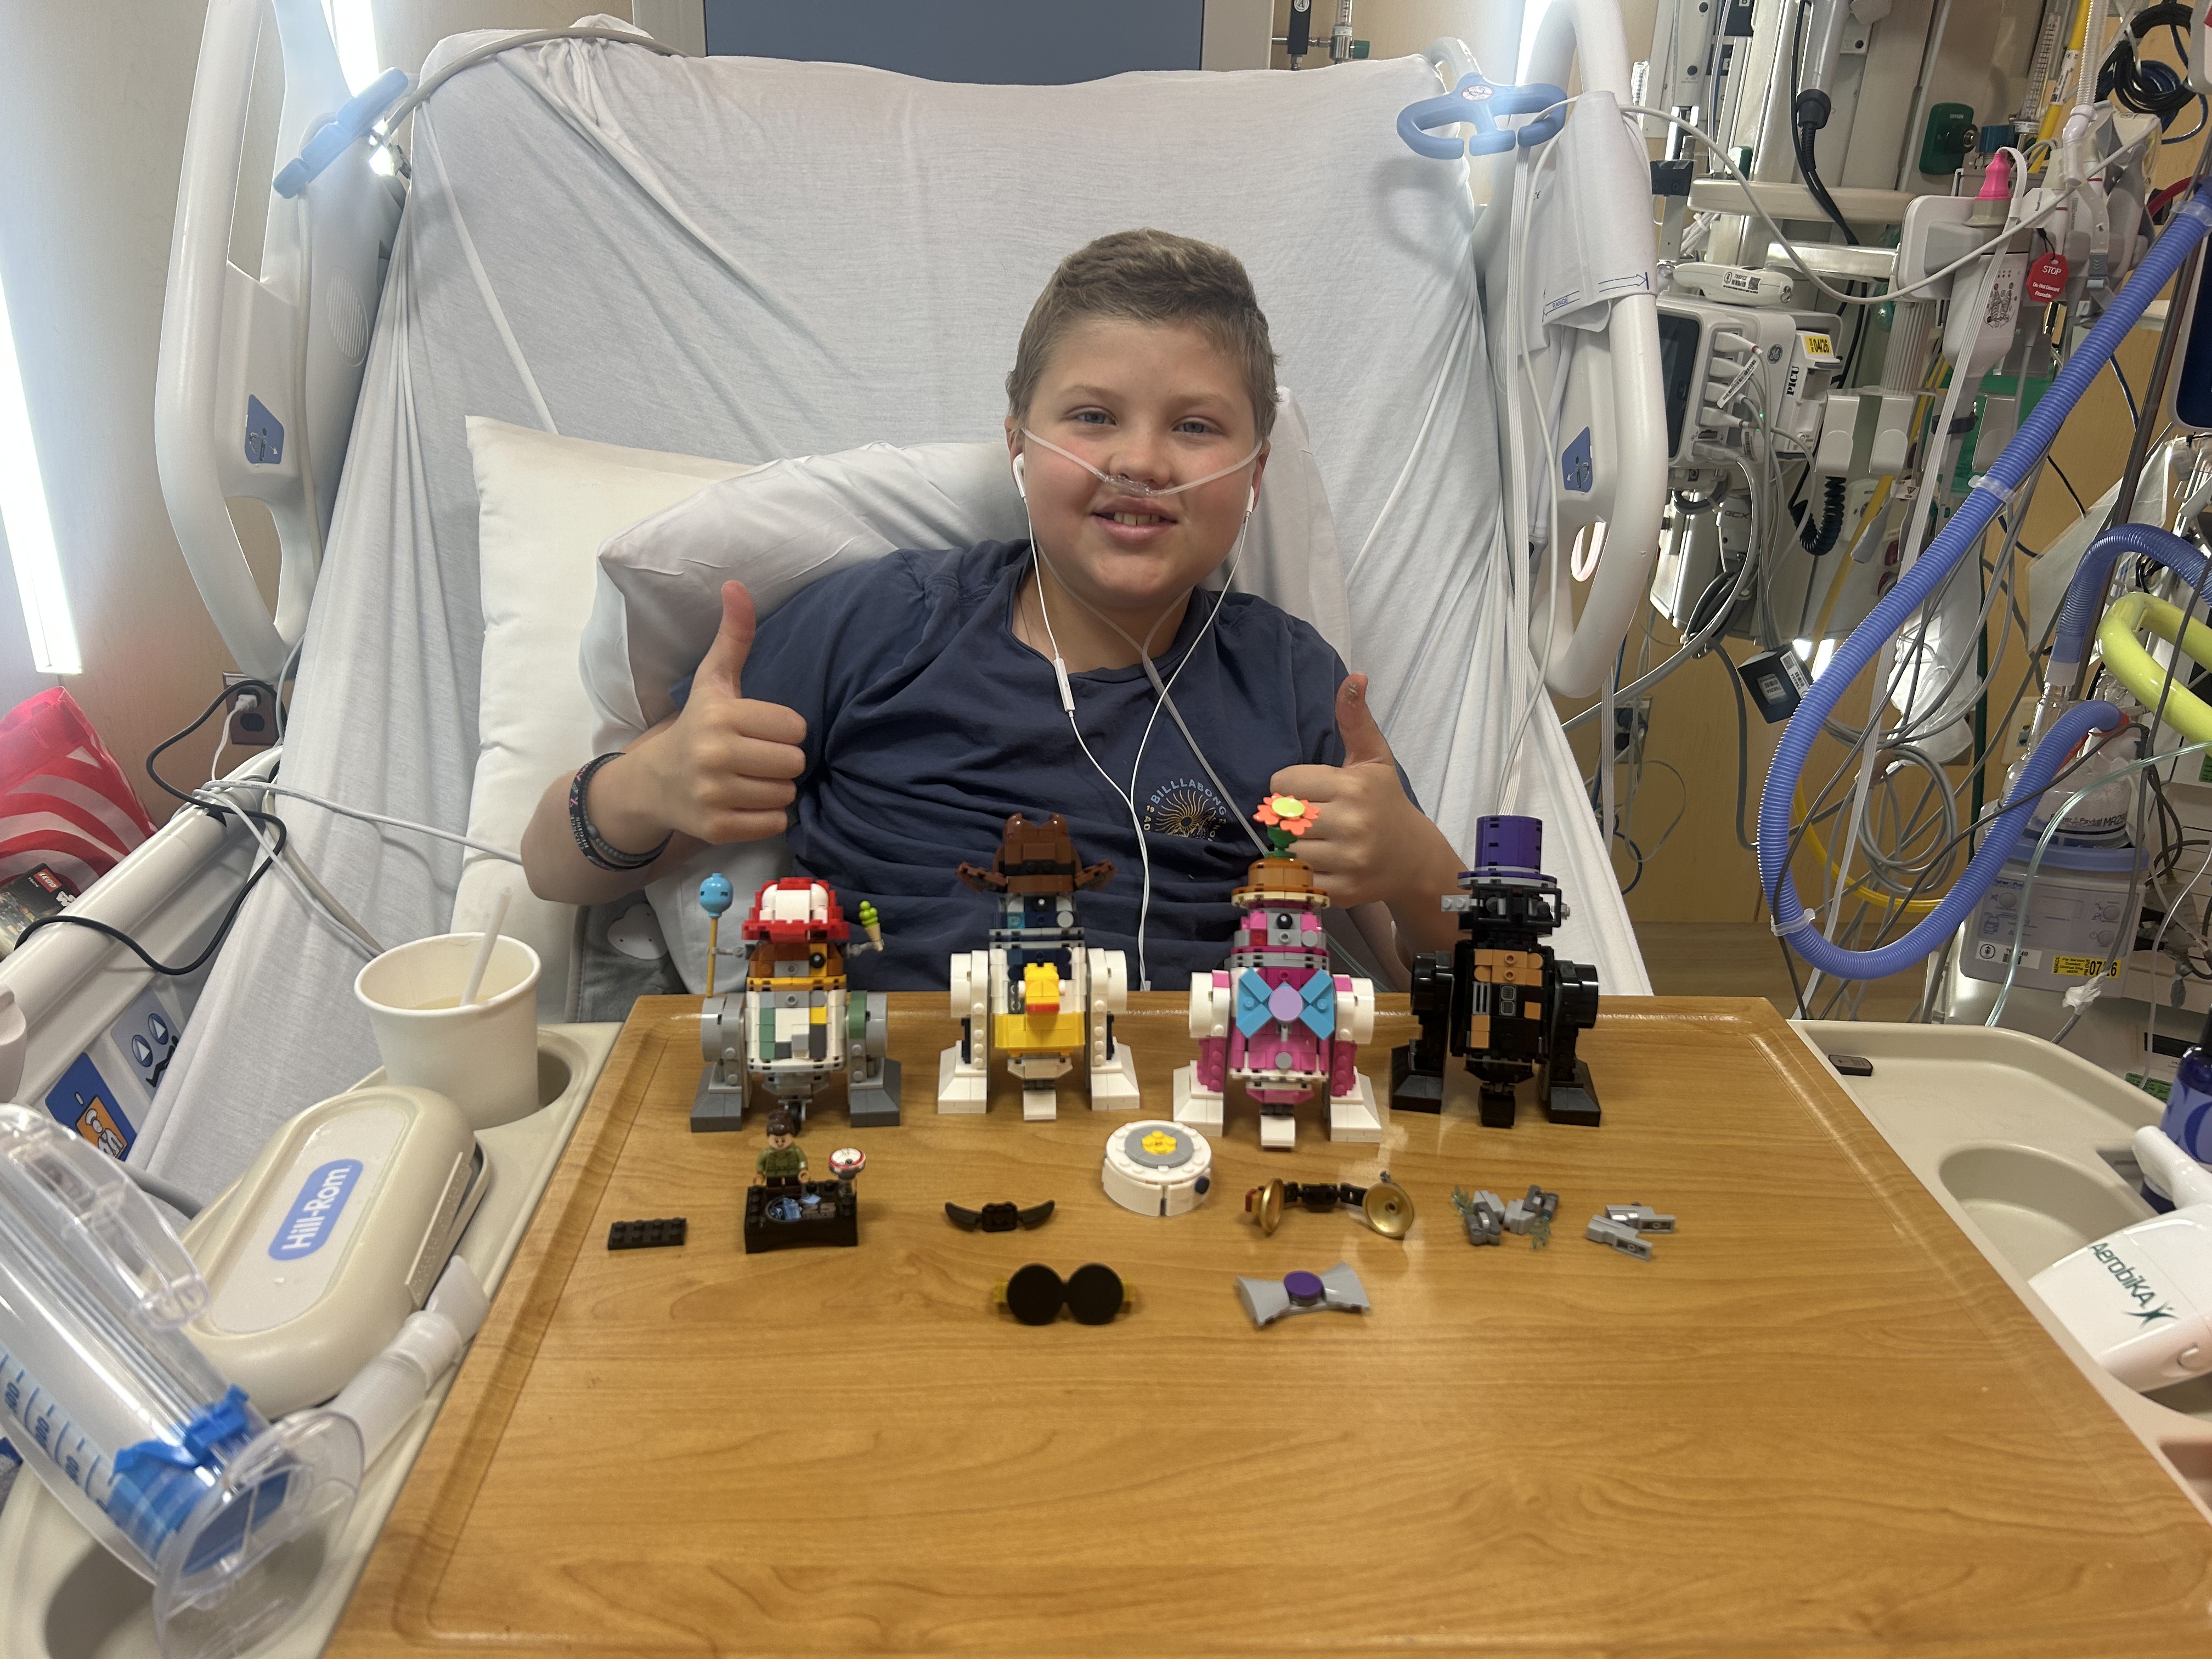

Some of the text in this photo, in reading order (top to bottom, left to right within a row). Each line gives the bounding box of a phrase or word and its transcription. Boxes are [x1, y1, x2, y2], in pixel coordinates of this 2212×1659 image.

[2042, 265, 2062, 275] STOP
[1552, 297, 1568, 309] RANGE
[1813, 338, 1830, 353] 04/26
[1786, 365, 1799, 396] PICU
[1725, 510, 1750, 519] GCX
[38, 872, 58, 888] LEGO
[281, 1167, 351, 1250] Hill-Rom
